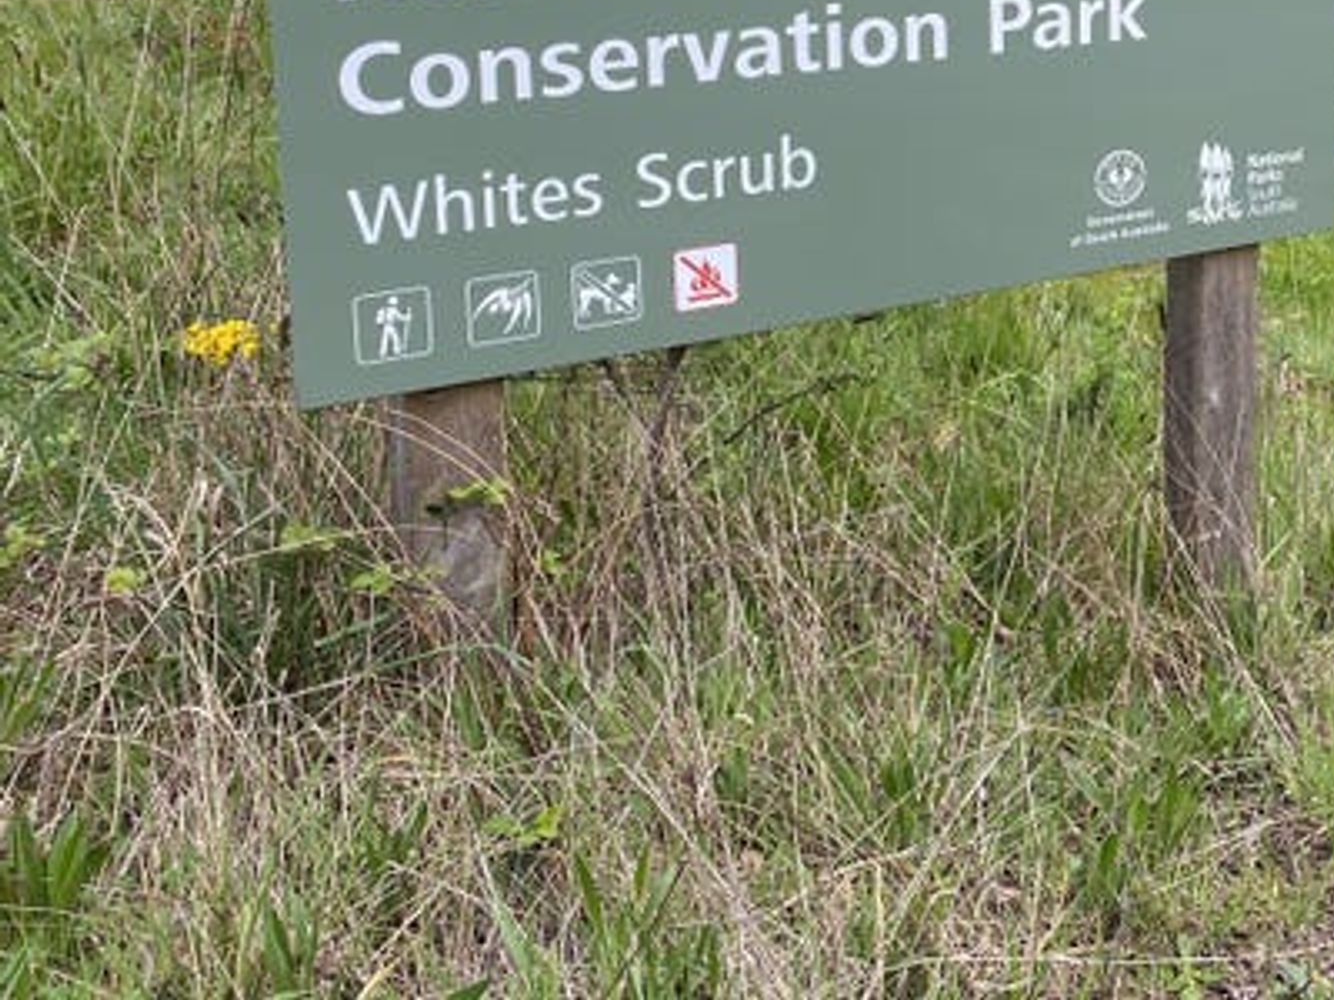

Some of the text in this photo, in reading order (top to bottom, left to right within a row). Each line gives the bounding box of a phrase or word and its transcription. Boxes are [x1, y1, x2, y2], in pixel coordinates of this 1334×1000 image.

[338, 2, 948, 115] Conservation
[347, 133, 818, 245] Whites Scrub
